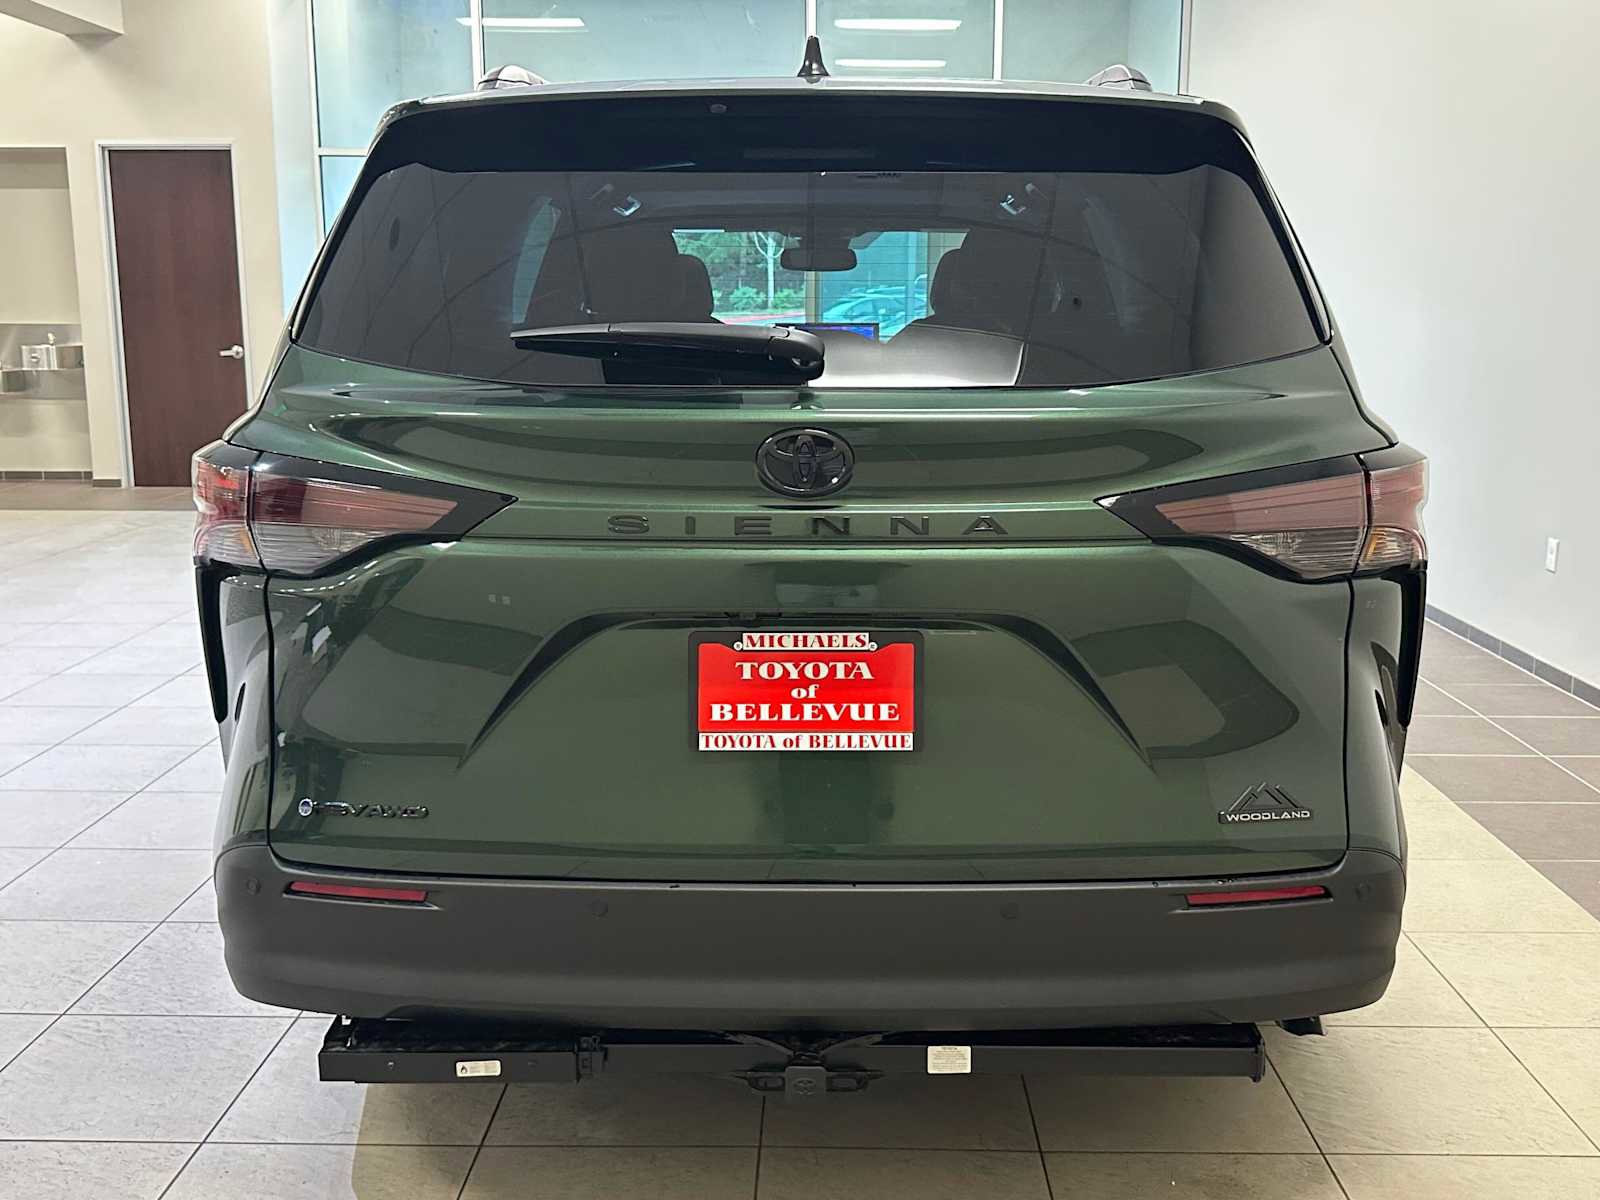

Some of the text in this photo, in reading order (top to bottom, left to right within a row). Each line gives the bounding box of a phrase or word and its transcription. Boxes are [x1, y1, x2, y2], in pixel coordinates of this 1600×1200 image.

[608, 515, 1009, 536] SIENNA
[745, 634, 868, 649] MICHAELS
[735, 661, 875, 680] TOYOTA
[790, 684, 820, 699] of
[709, 703, 900, 721] BELLEVUE
[701, 734, 912, 749] TOYOTA of BELLEVUE
[1225, 810, 1311, 822] WOODLAND
